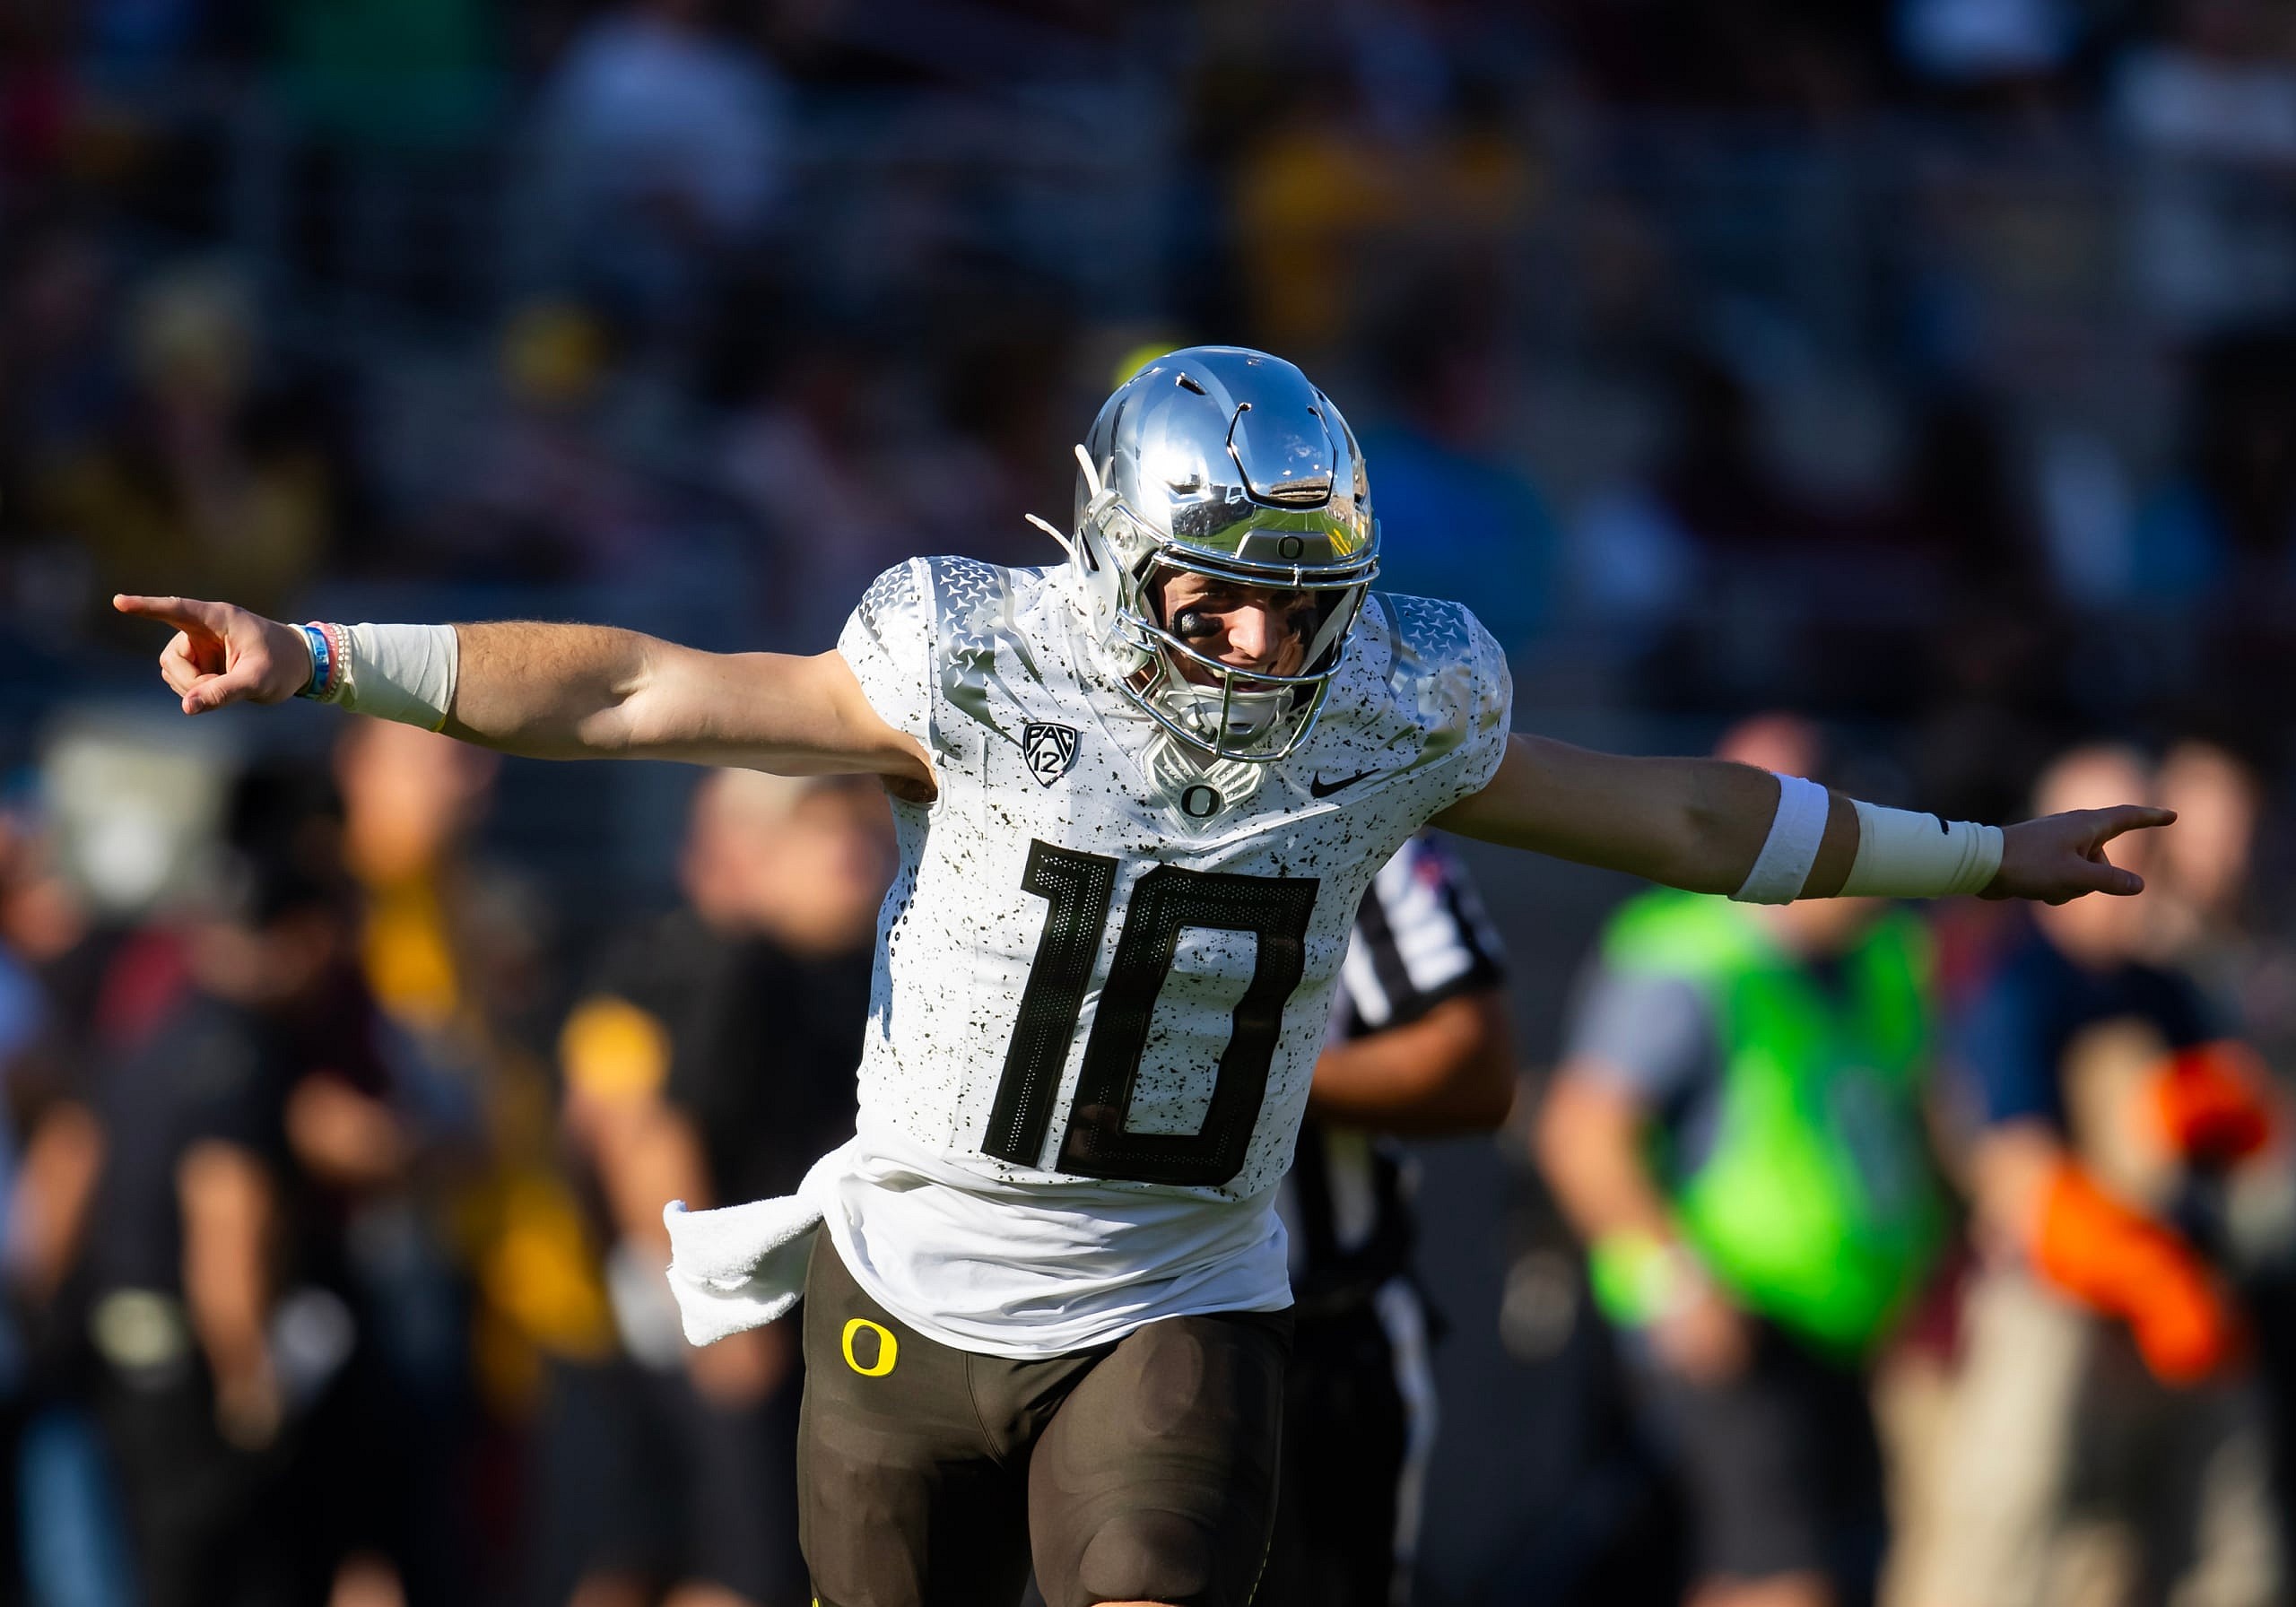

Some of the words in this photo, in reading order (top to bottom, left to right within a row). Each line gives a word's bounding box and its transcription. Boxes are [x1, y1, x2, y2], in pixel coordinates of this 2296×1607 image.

[1278, 536, 1304, 560] O
[1027, 726, 1074, 763] PAC
[1034, 751, 1060, 773] 12
[1180, 785, 1221, 818] O
[980, 838, 1320, 1186] 10
[842, 1317, 898, 1377] O
